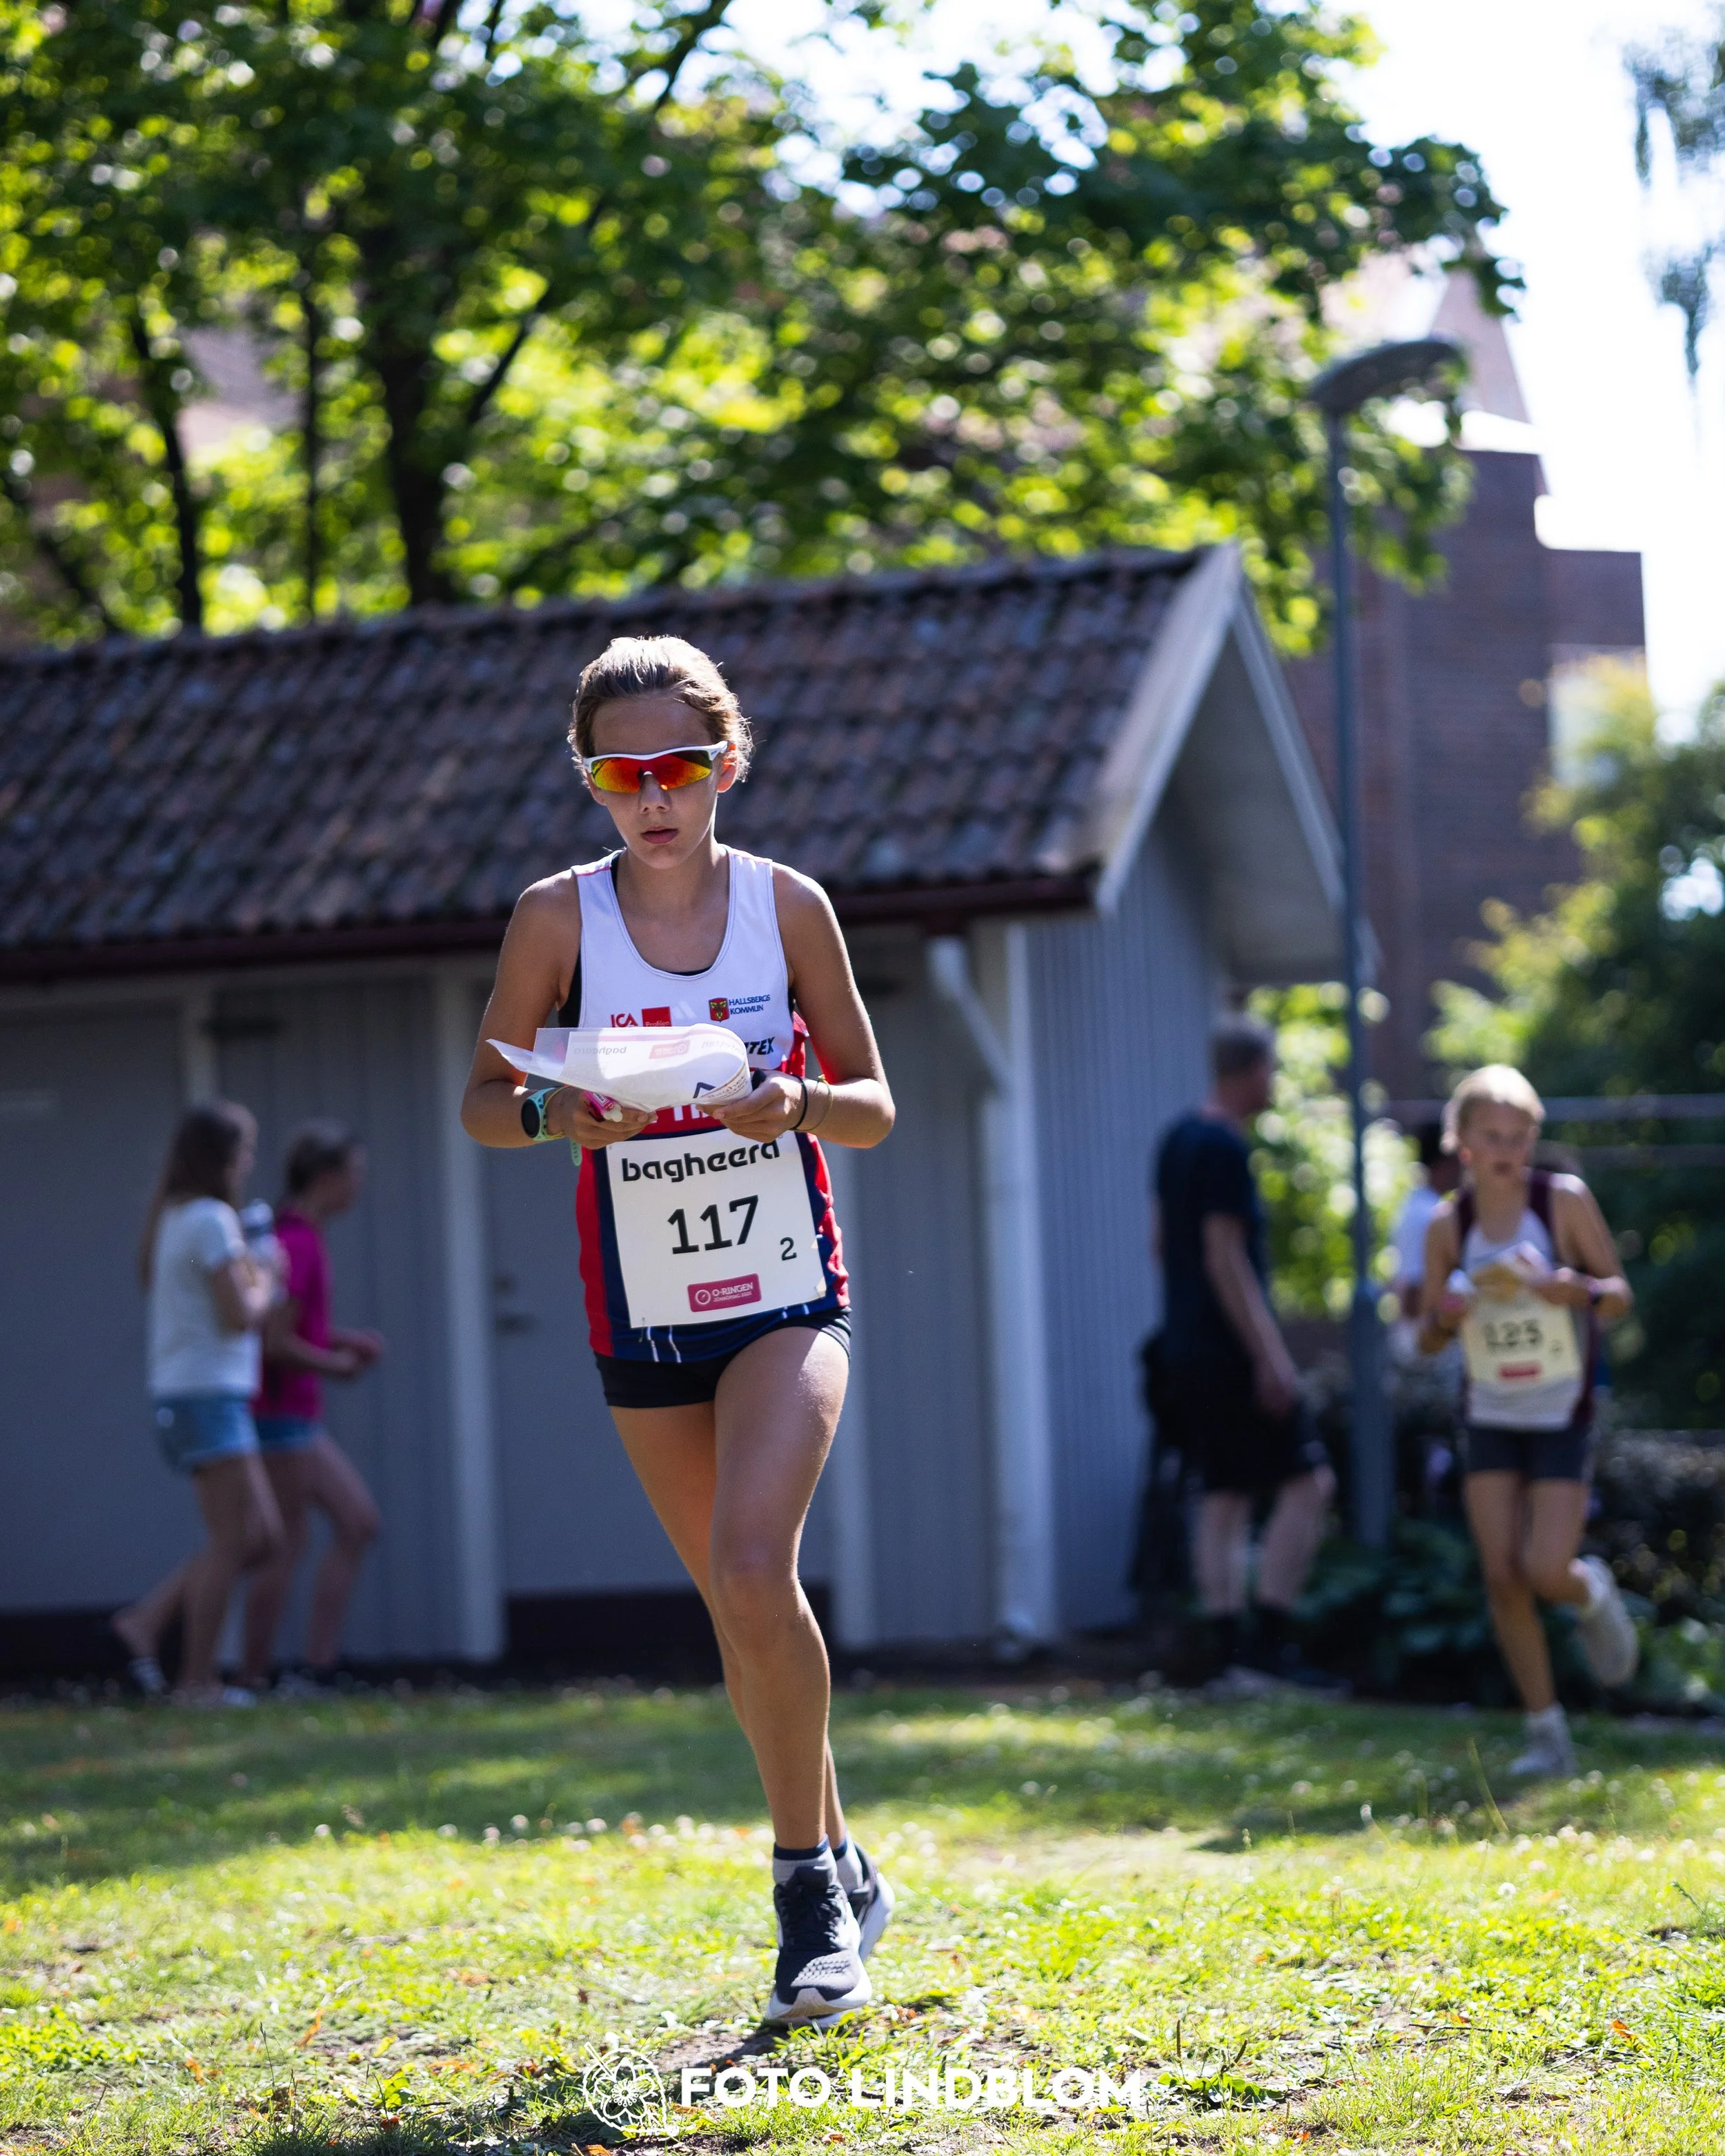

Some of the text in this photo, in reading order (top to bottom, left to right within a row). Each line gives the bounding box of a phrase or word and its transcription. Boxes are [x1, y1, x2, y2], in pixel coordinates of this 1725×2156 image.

[729, 994, 771, 1006] HALLSBERGS
[730, 1005, 764, 1015] KOMMUN
[611, 1013, 639, 1027] ICA
[622, 1139, 780, 1183] bagheera
[667, 1195, 758, 1254] 117
[780, 1237, 797, 1261] 2
[712, 1283, 753, 1296] O-RINGEN
